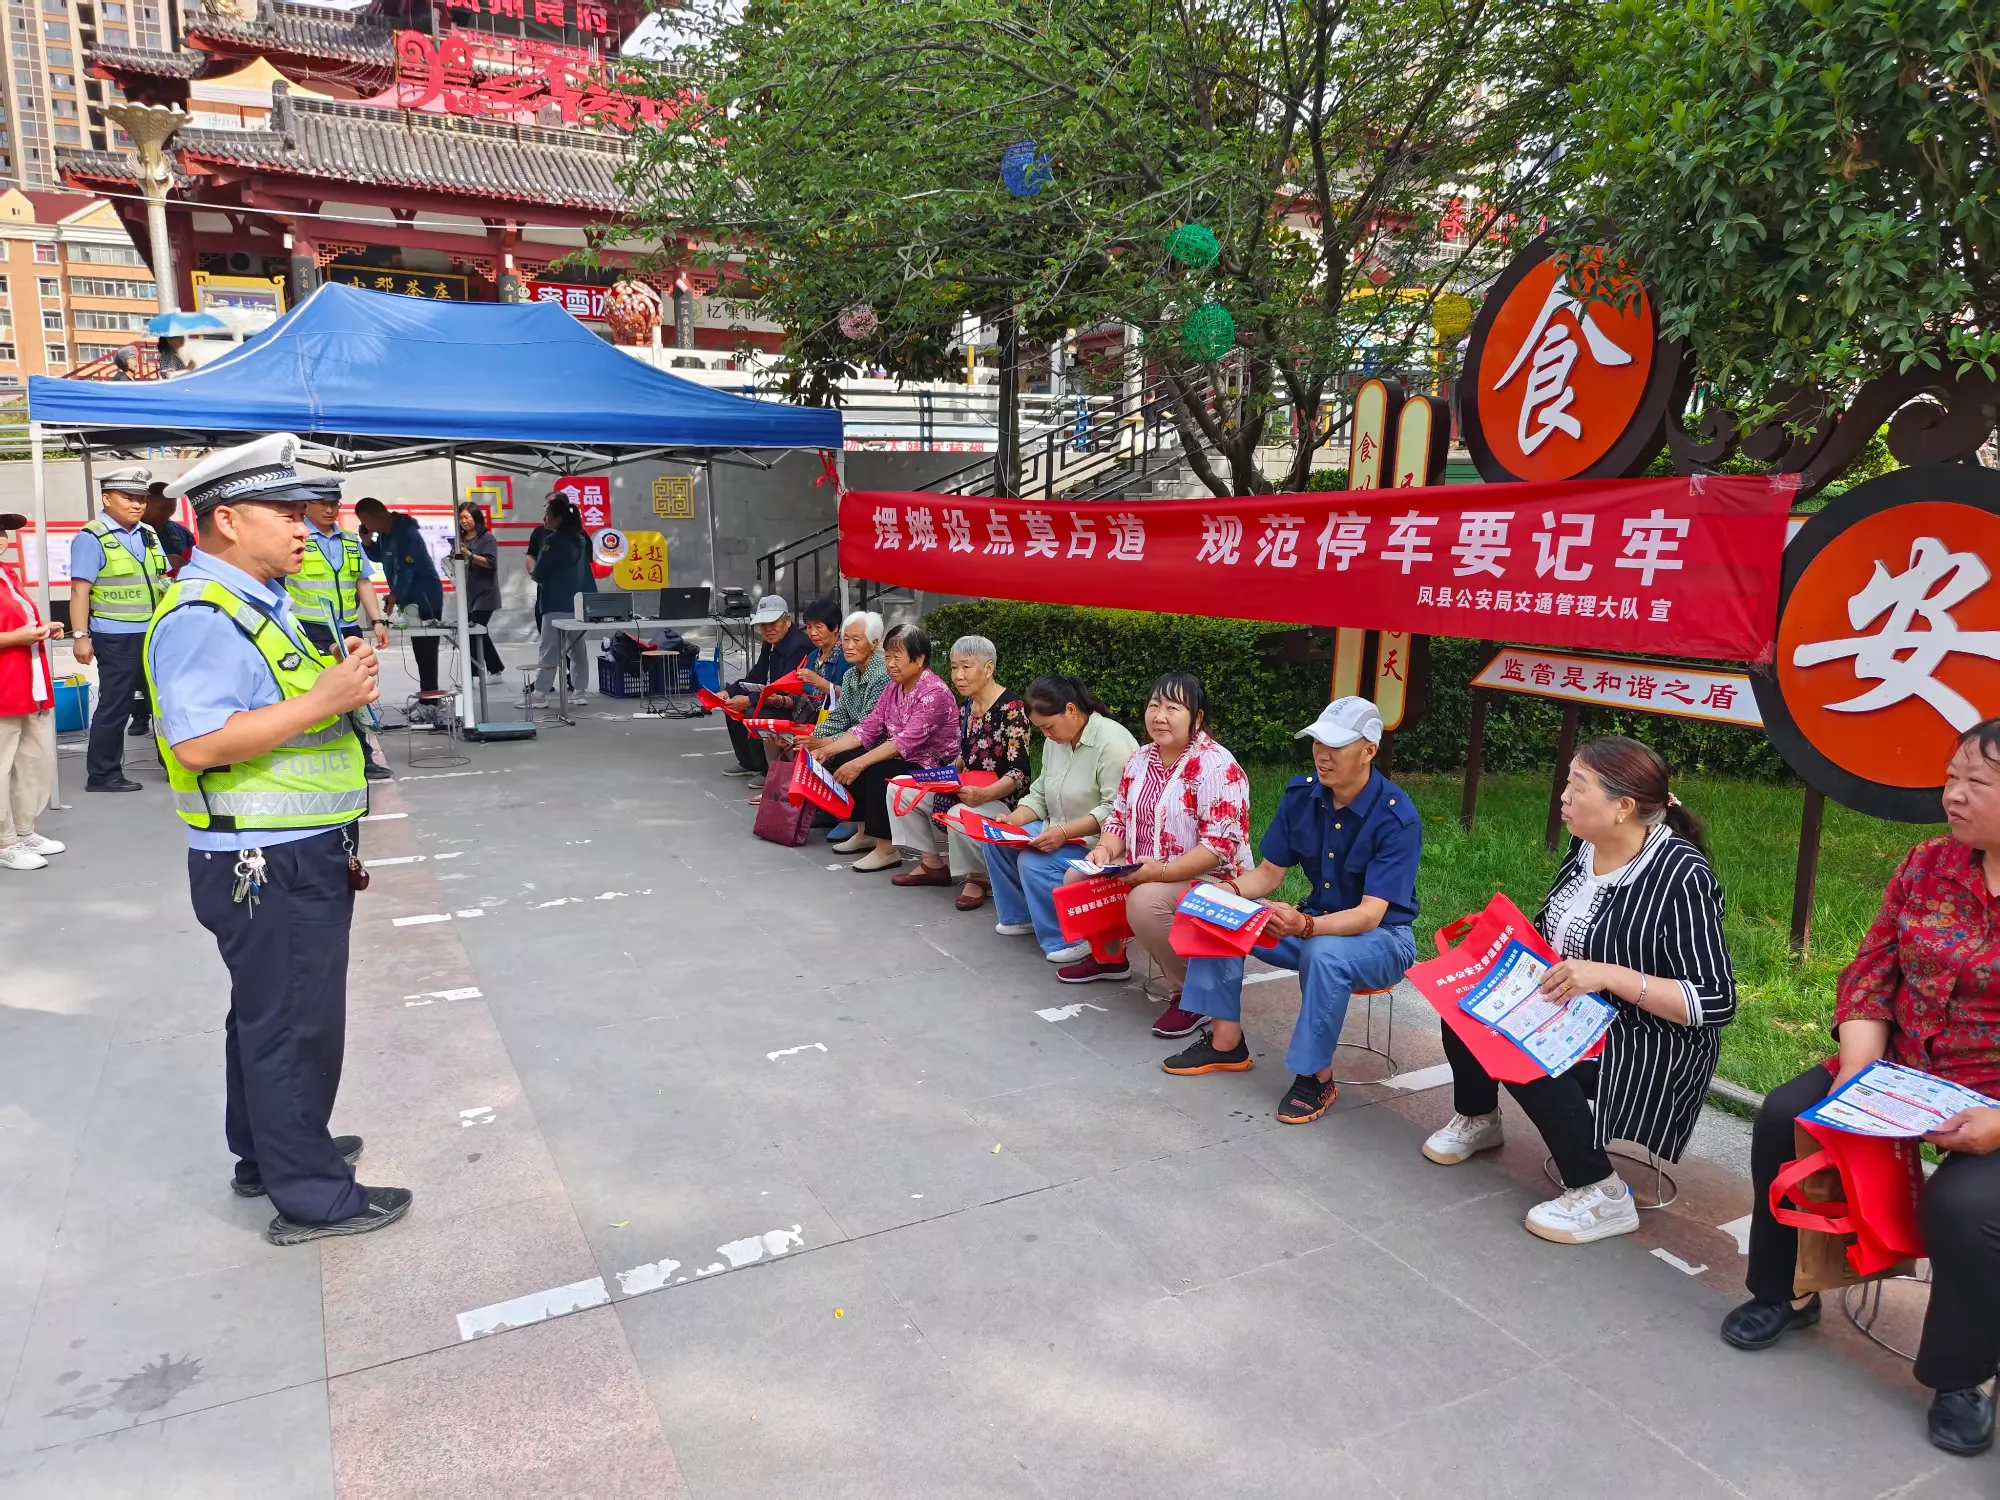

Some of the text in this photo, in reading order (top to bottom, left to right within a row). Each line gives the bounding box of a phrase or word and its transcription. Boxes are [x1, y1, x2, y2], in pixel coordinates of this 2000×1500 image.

[1493, 273, 1632, 456] 食
[560, 485, 604, 505] 食品
[629, 544, 664, 562] 主题
[872, 505, 1691, 588] 摆摊设点莫占道 规范停车要记牢
[103, 590, 142, 600] POLICE
[1416, 585, 1673, 623] 凤县公安局交通管理大队 宣
[1793, 536, 2000, 733] 安
[1500, 658, 1739, 710] 监管是和谐之盾
[272, 749, 351, 778] POLICE
[1435, 924, 1515, 987] 凤县公安交警温馨提示
[1455, 981, 1481, 995] 机动车
